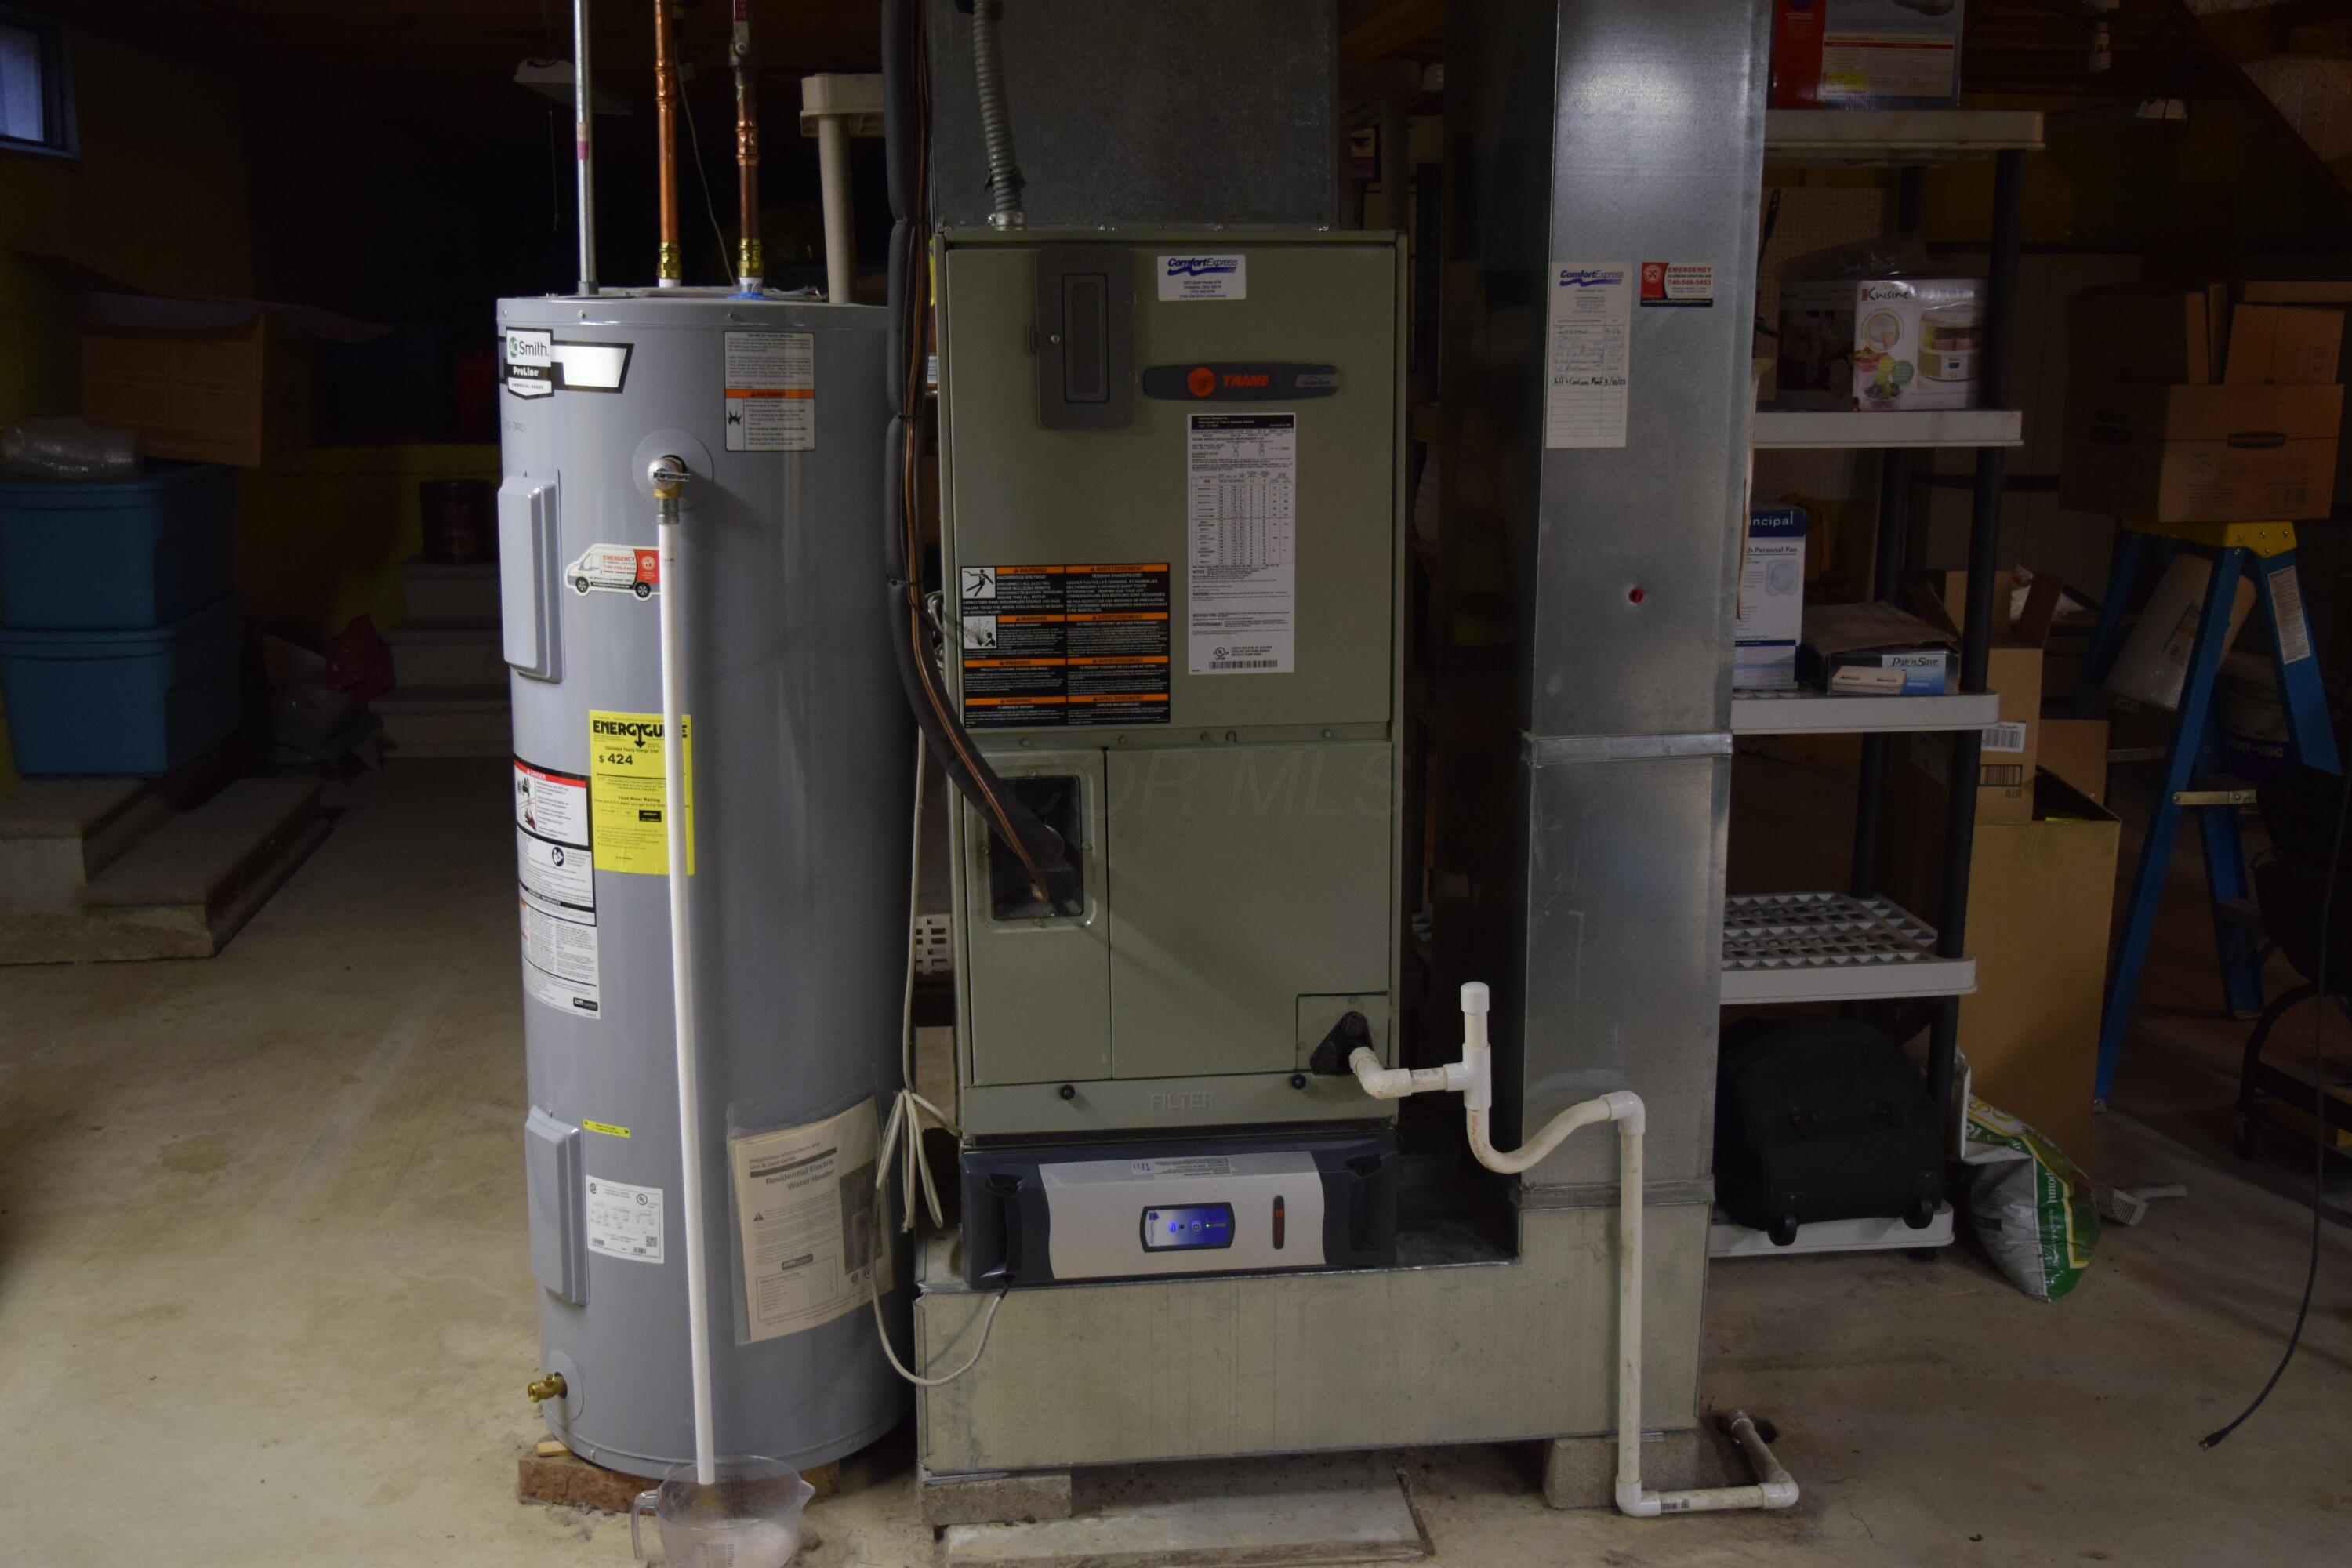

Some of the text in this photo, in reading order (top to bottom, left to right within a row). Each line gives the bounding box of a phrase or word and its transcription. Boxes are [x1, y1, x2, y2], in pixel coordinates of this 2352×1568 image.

[1868, 287, 1909, 301] Cuisine
[519, 340, 547, 357] Smith
[514, 366, 539, 376] ProLine
[1222, 374, 1270, 387] TRANE
[1918, 657, 1939, 666] Save
[608, 754, 633, 765] 424
[1151, 1091, 1216, 1111] FILTER
[766, 1158, 835, 1185] Residential Electric
[787, 1169, 835, 1190] Water Heater
